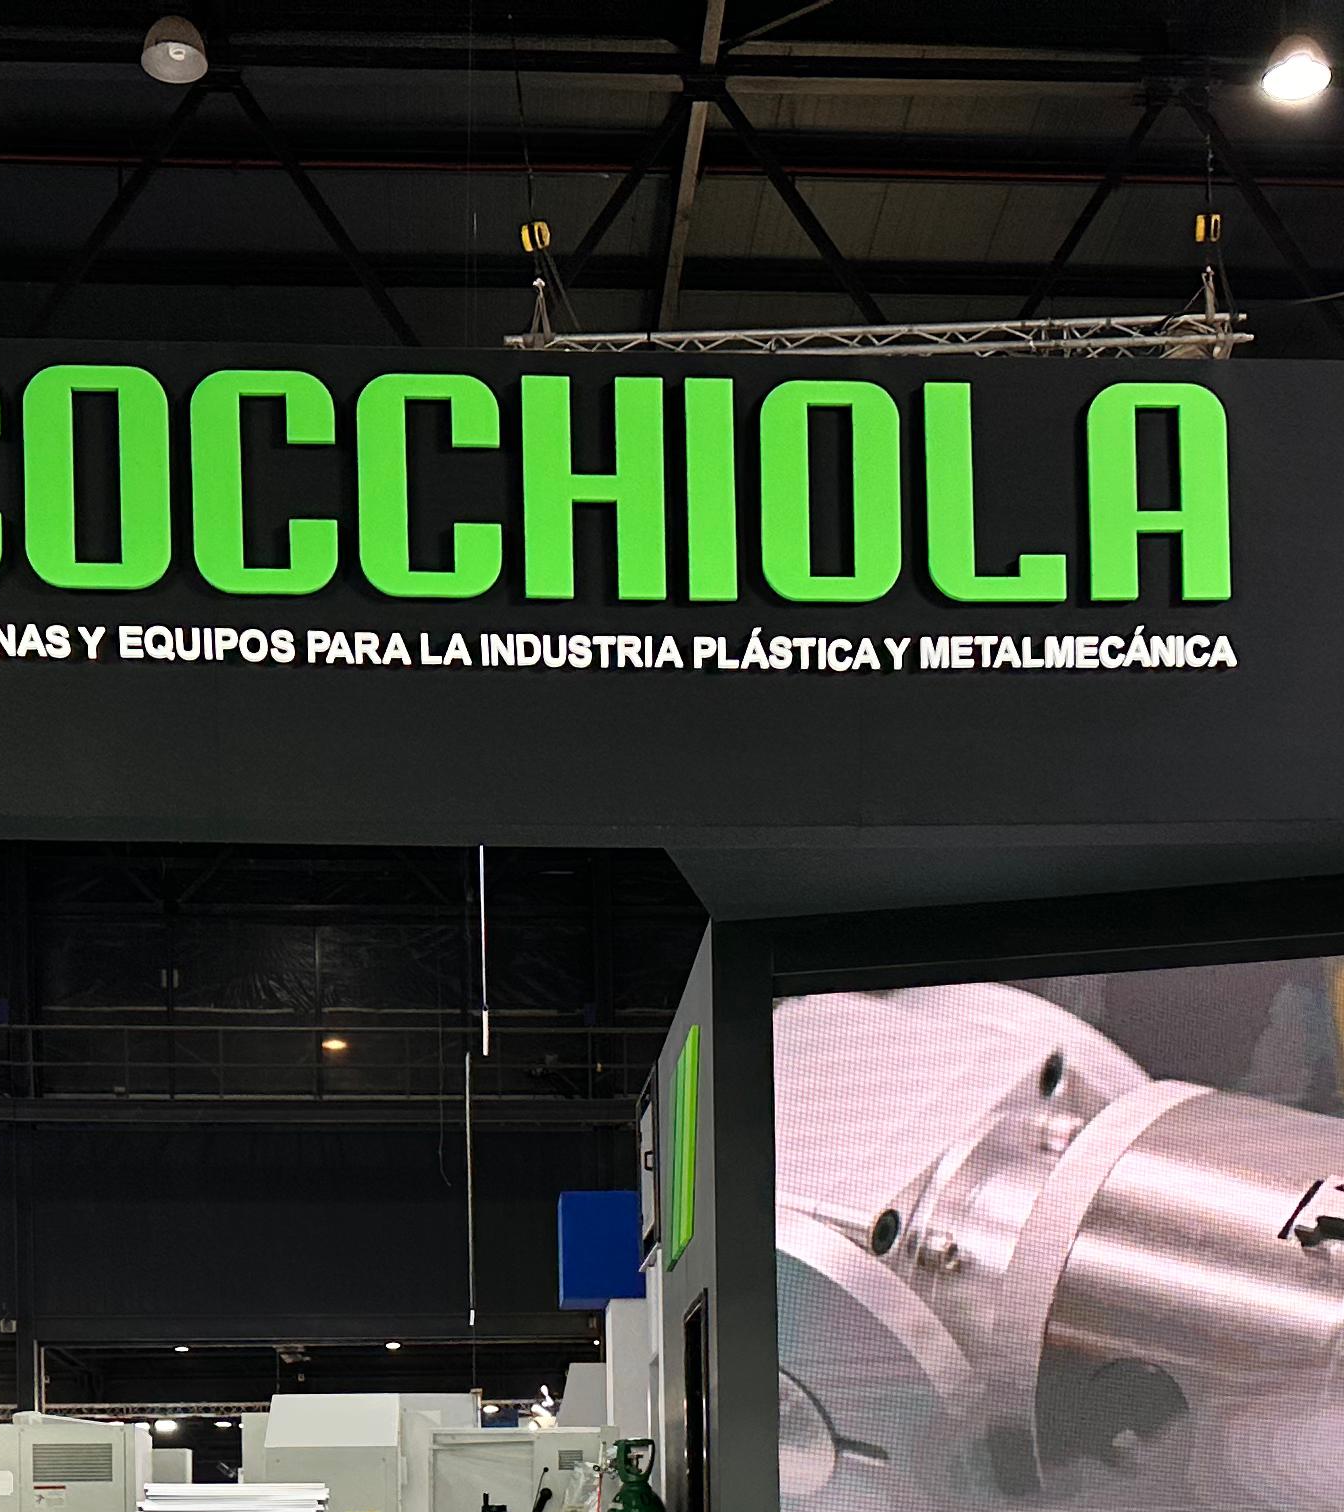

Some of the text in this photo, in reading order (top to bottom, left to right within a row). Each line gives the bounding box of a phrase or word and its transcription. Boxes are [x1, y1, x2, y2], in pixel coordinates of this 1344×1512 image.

[77, 626, 106, 660] Y
[118, 625, 296, 664] EQUIPOS
[306, 629, 412, 666] PARA
[420, 632, 473, 667] LA
[480, 633, 683, 669] INDUSTRIA
[692, 626, 882, 672] PLÁSTICA
[882, 637, 912, 671] Y
[919, 624, 1238, 670] METALMECÁNICA
